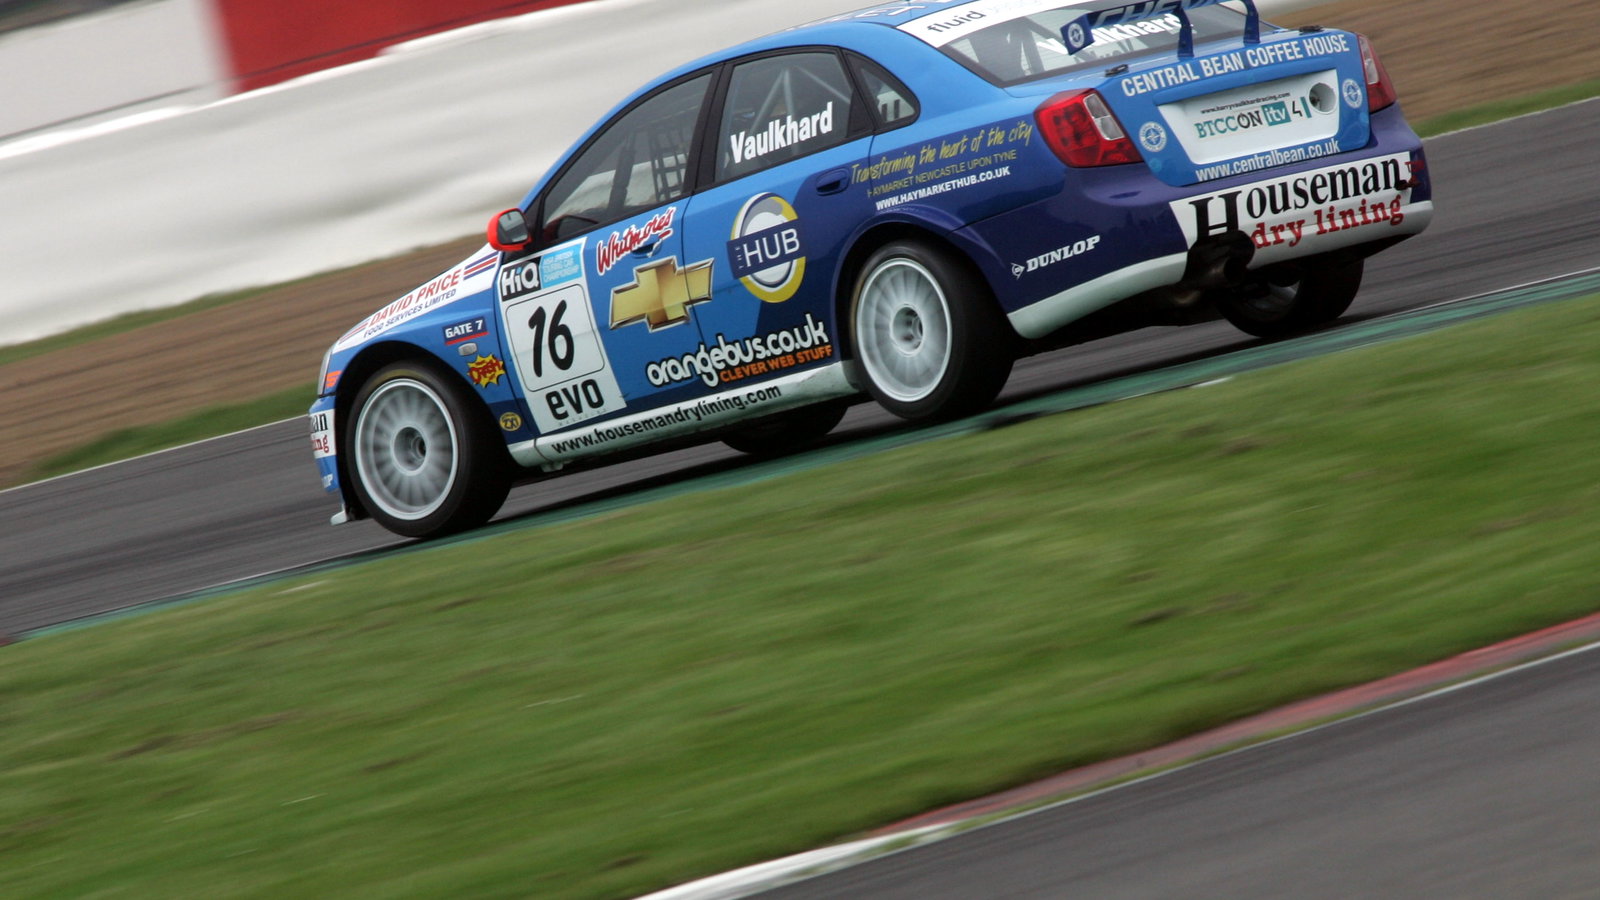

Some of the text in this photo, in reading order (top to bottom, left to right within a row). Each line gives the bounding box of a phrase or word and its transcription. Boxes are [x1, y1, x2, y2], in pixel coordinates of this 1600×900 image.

[926, 9, 987, 33] fluid
[1121, 33, 1350, 97] CENTRAL BEAN COFFEE HOUSE
[730, 101, 833, 164] Vaulkhard
[850, 120, 1033, 185] Transforming the heart of the city
[867, 149, 1018, 198] HAYMARKET NEWCASTLE UPON TYNE
[1195, 138, 1341, 182] www.centralbean.co.uk
[875, 166, 1011, 211] WWW.HAYMARKETHUB.CO.UK
[1189, 158, 1401, 243] Houseman
[1250, 195, 1405, 249] dry lining
[742, 228, 801, 268] HUB
[1026, 234, 1101, 273] DUNLOP
[368, 269, 462, 327] DAVID PRICE
[502, 260, 541, 297] HiQ
[362, 288, 457, 340] FOOD SERVICES LIMITED
[444, 319, 484, 339] GATE 7
[528, 300, 575, 377] 16
[646, 313, 829, 387] orangebus.co.uk
[719, 345, 832, 383] CLEVER WEB STUFF
[545, 378, 605, 421] evo
[551, 385, 782, 455] www.housemandrylining.com
